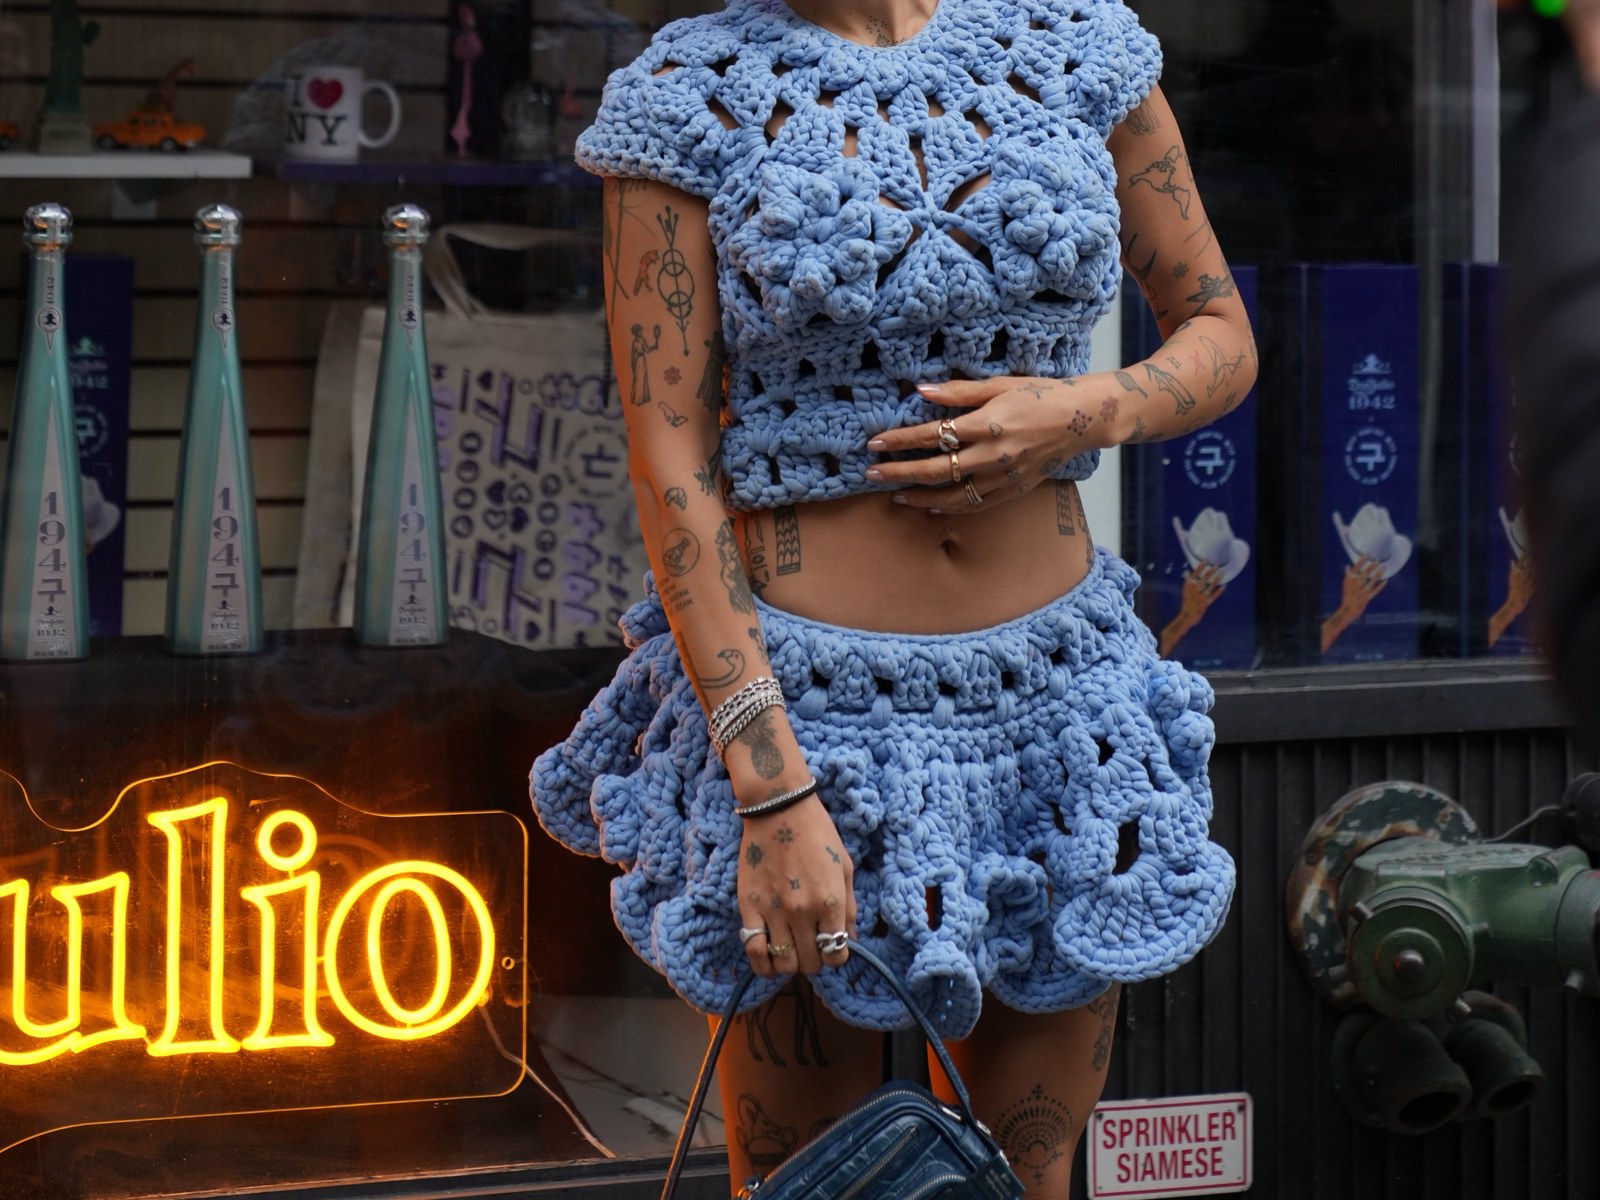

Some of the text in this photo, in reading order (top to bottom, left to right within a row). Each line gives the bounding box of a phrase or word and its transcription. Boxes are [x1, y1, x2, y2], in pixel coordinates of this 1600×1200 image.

[287, 111, 347, 147] NY
[0, 796, 496, 1067] ulio
[1102, 1111, 1236, 1150] SPRINKLER
[1116, 1146, 1224, 1184] SIAMESE
